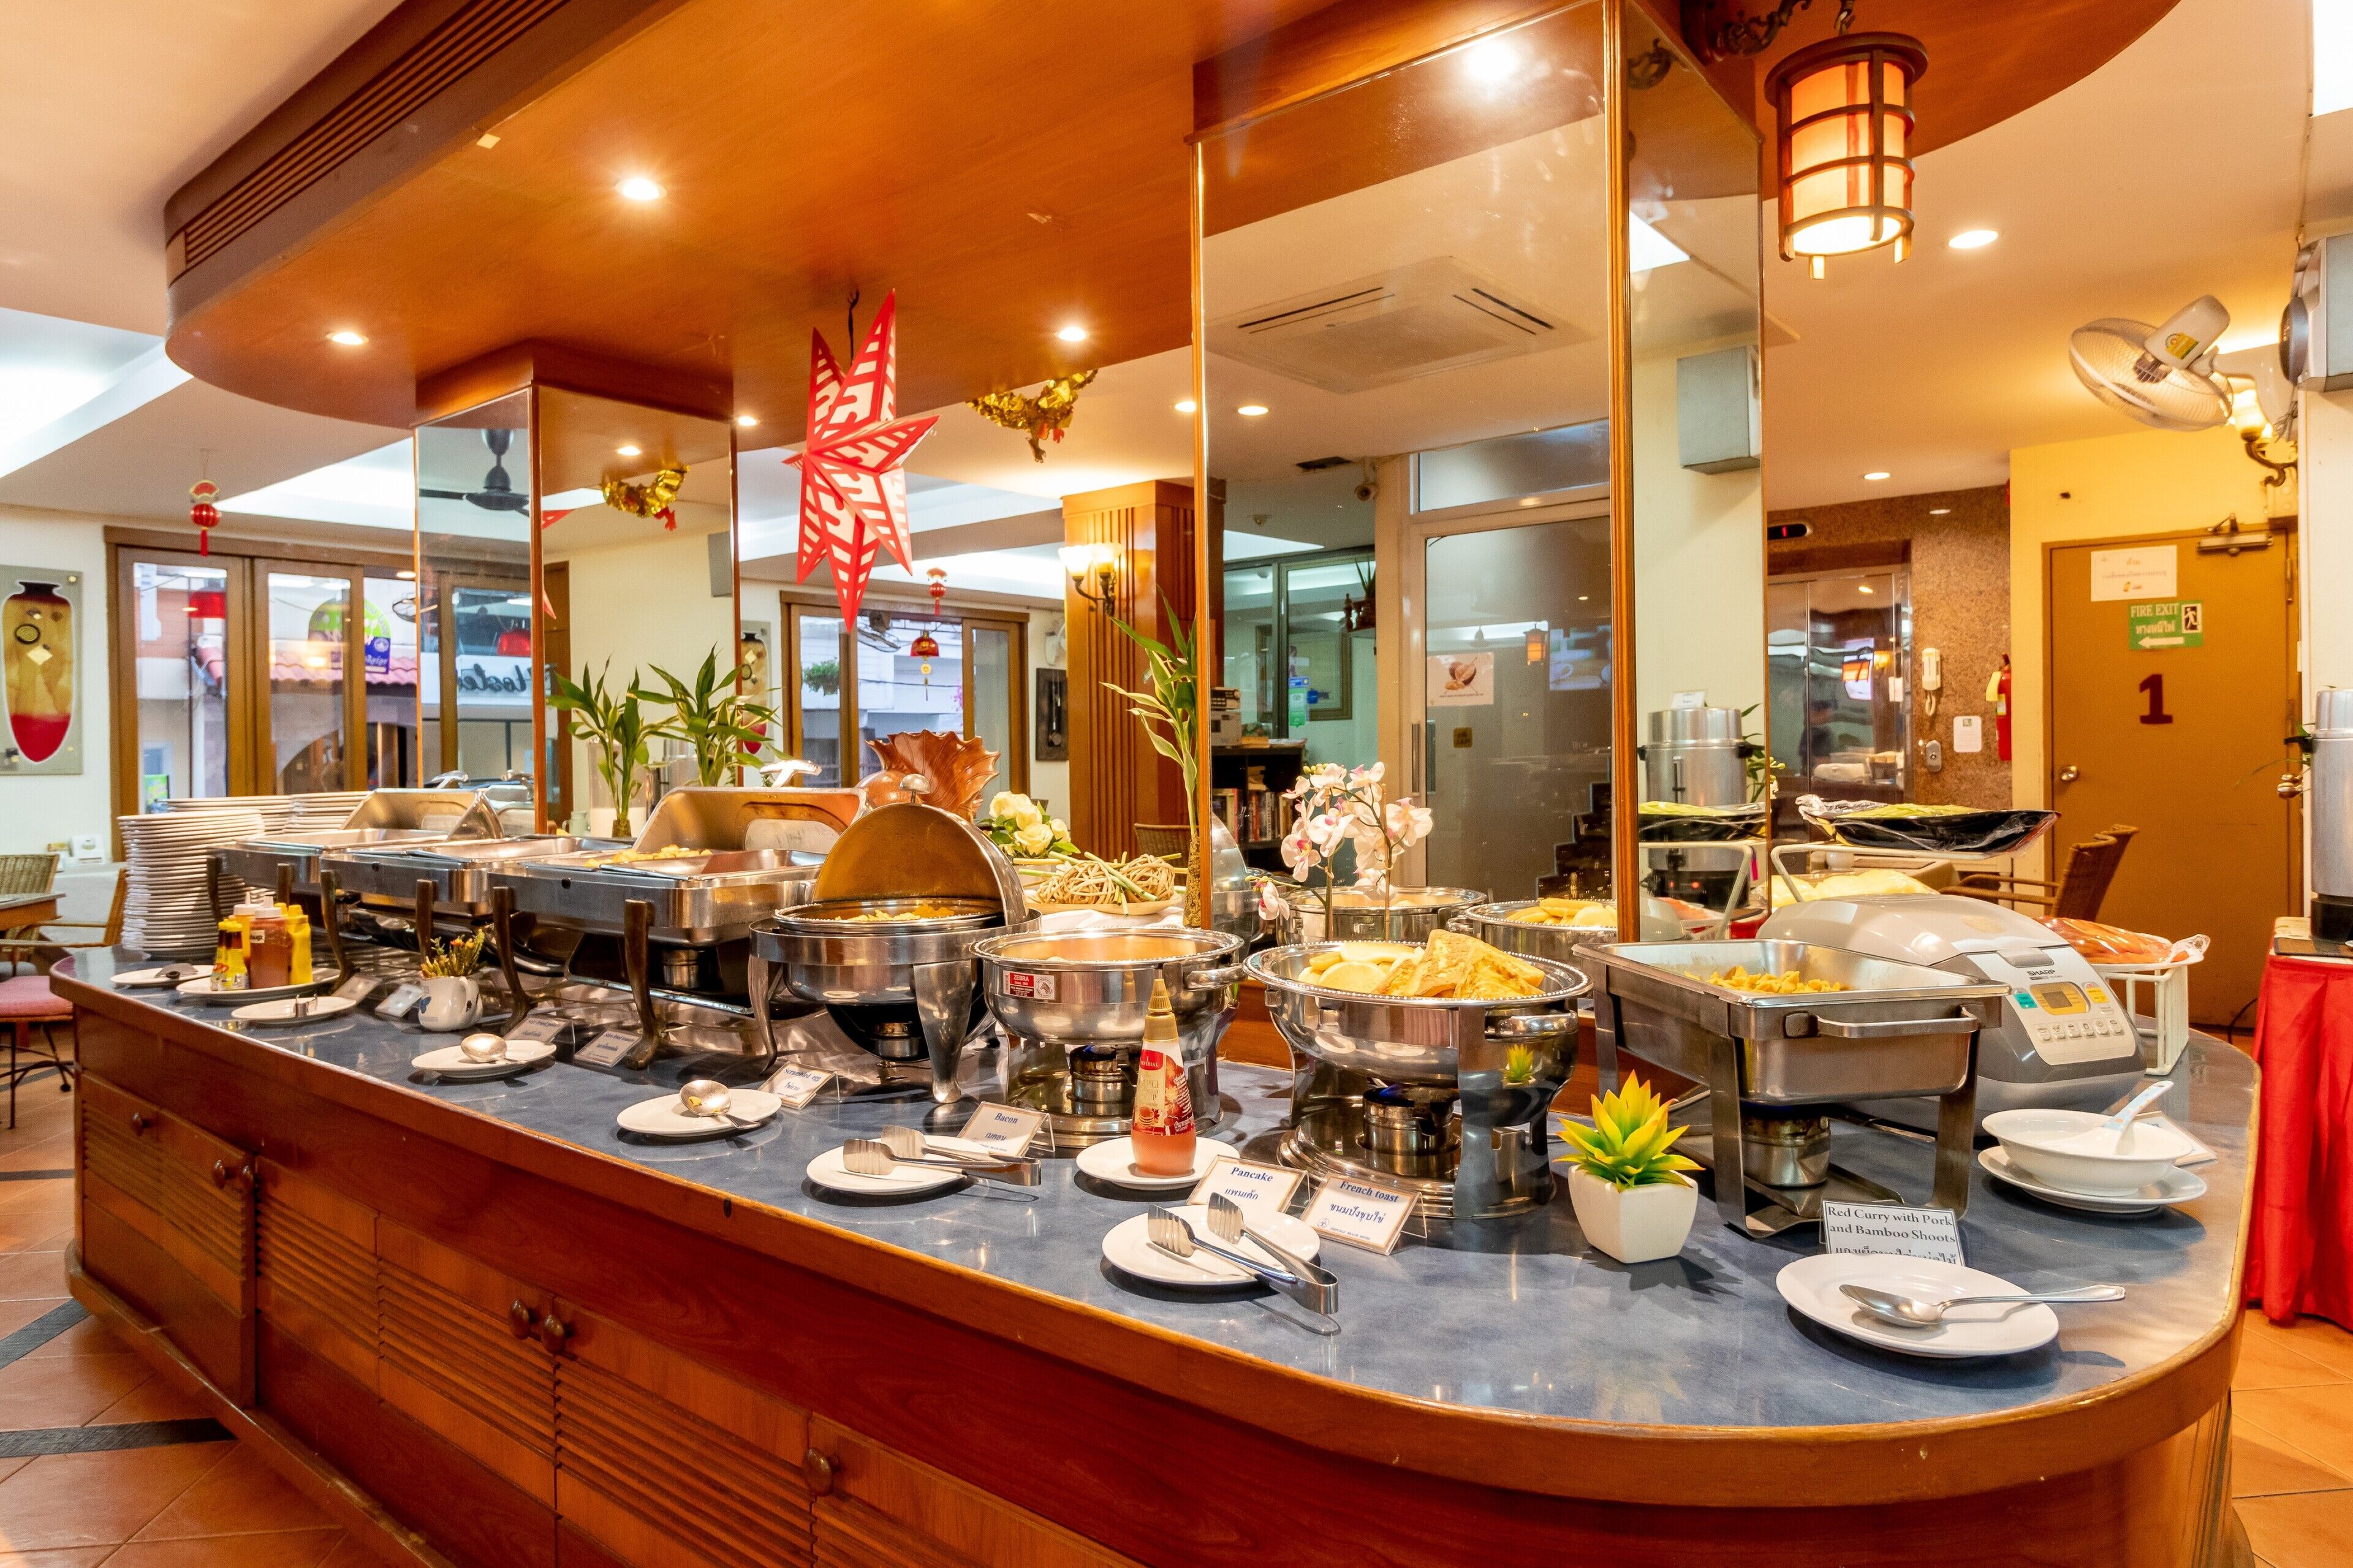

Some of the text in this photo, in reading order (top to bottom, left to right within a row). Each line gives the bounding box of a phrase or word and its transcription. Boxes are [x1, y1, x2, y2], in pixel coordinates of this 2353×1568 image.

[2131, 603, 2180, 618] FIRE EXIT
[2139, 673, 2173, 724] 1
[994, 1112, 1018, 1124] Bacon
[1230, 1167, 1273, 1182] Pancake
[1339, 1181, 1400, 1203] French toast
[1828, 1206, 1953, 1226] Red Curry with Pork
[1830, 1224, 1957, 1243] and Bamboo Shoots
